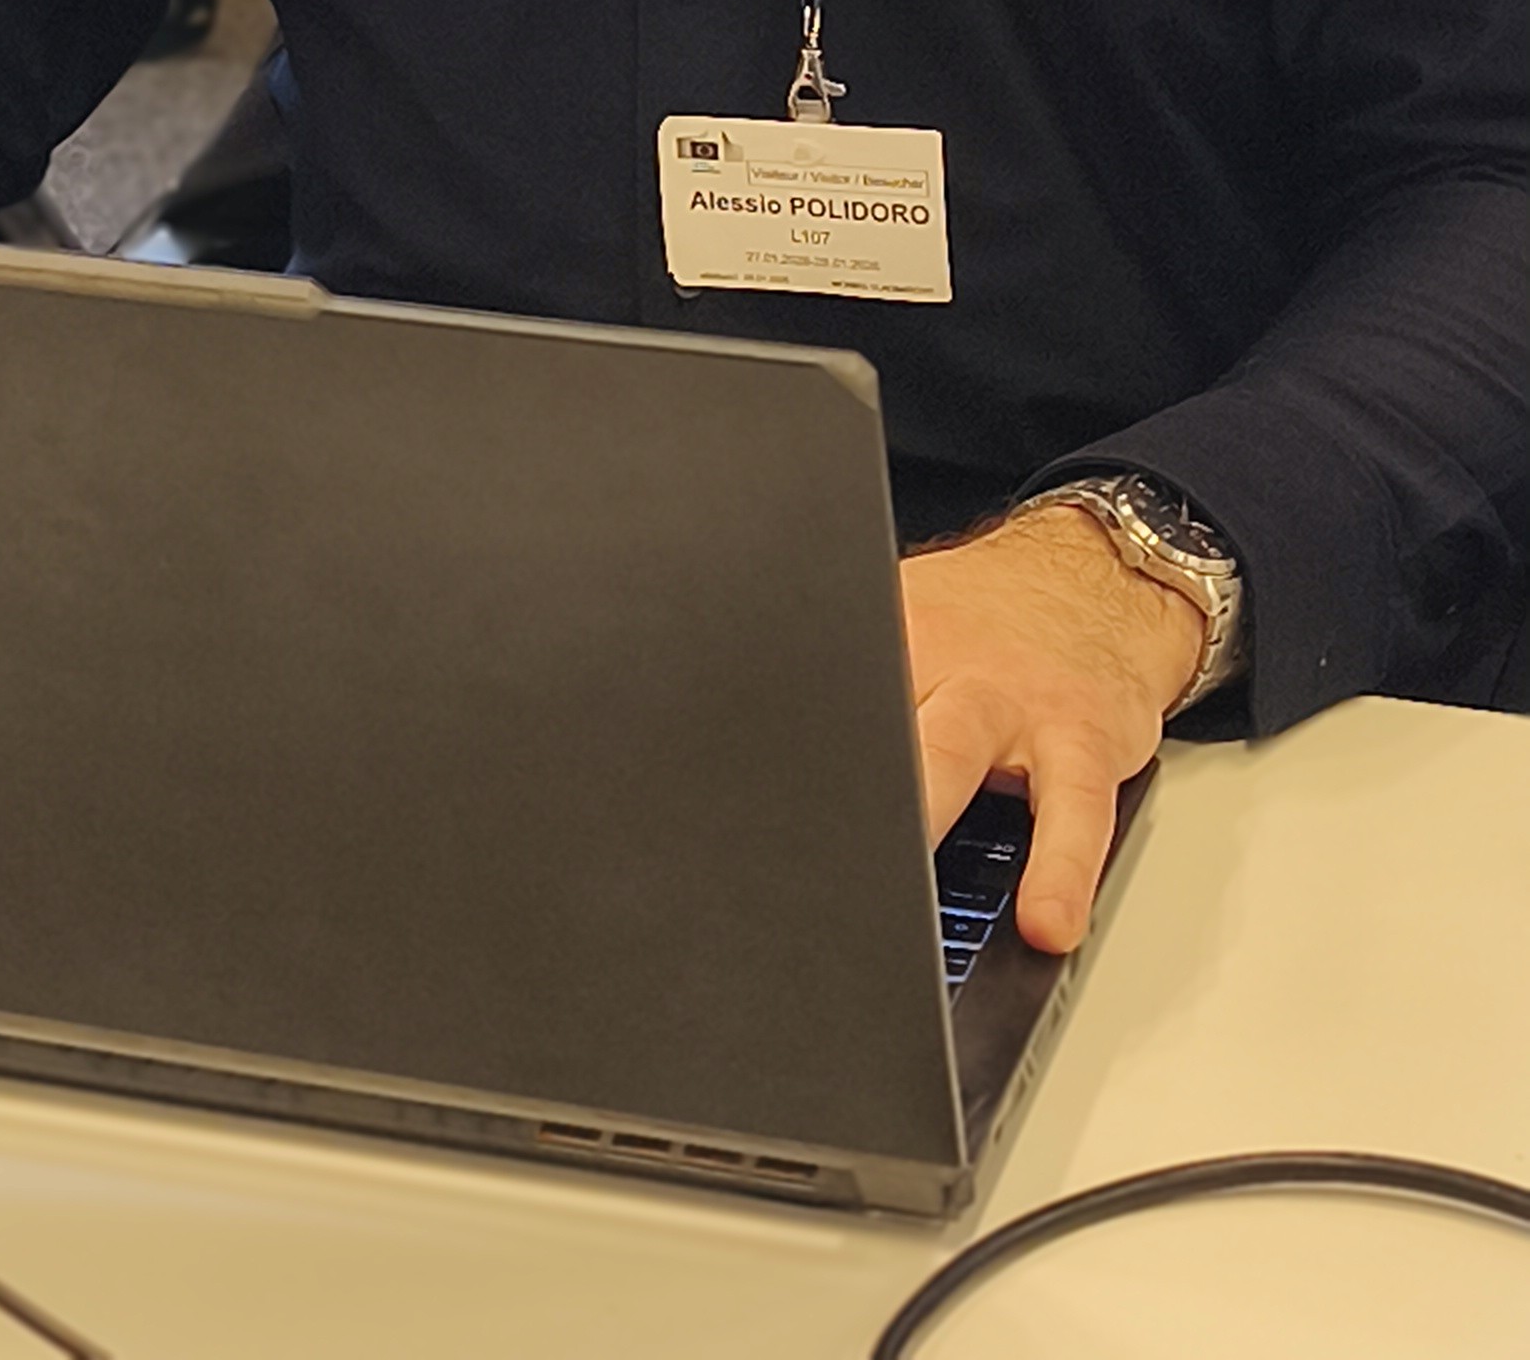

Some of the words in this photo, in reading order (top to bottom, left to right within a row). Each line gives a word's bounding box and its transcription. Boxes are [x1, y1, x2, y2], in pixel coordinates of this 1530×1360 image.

[690, 191, 782, 215] Alessio
[790, 197, 930, 225] POLIDORO
[791, 229, 831, 245] L107
